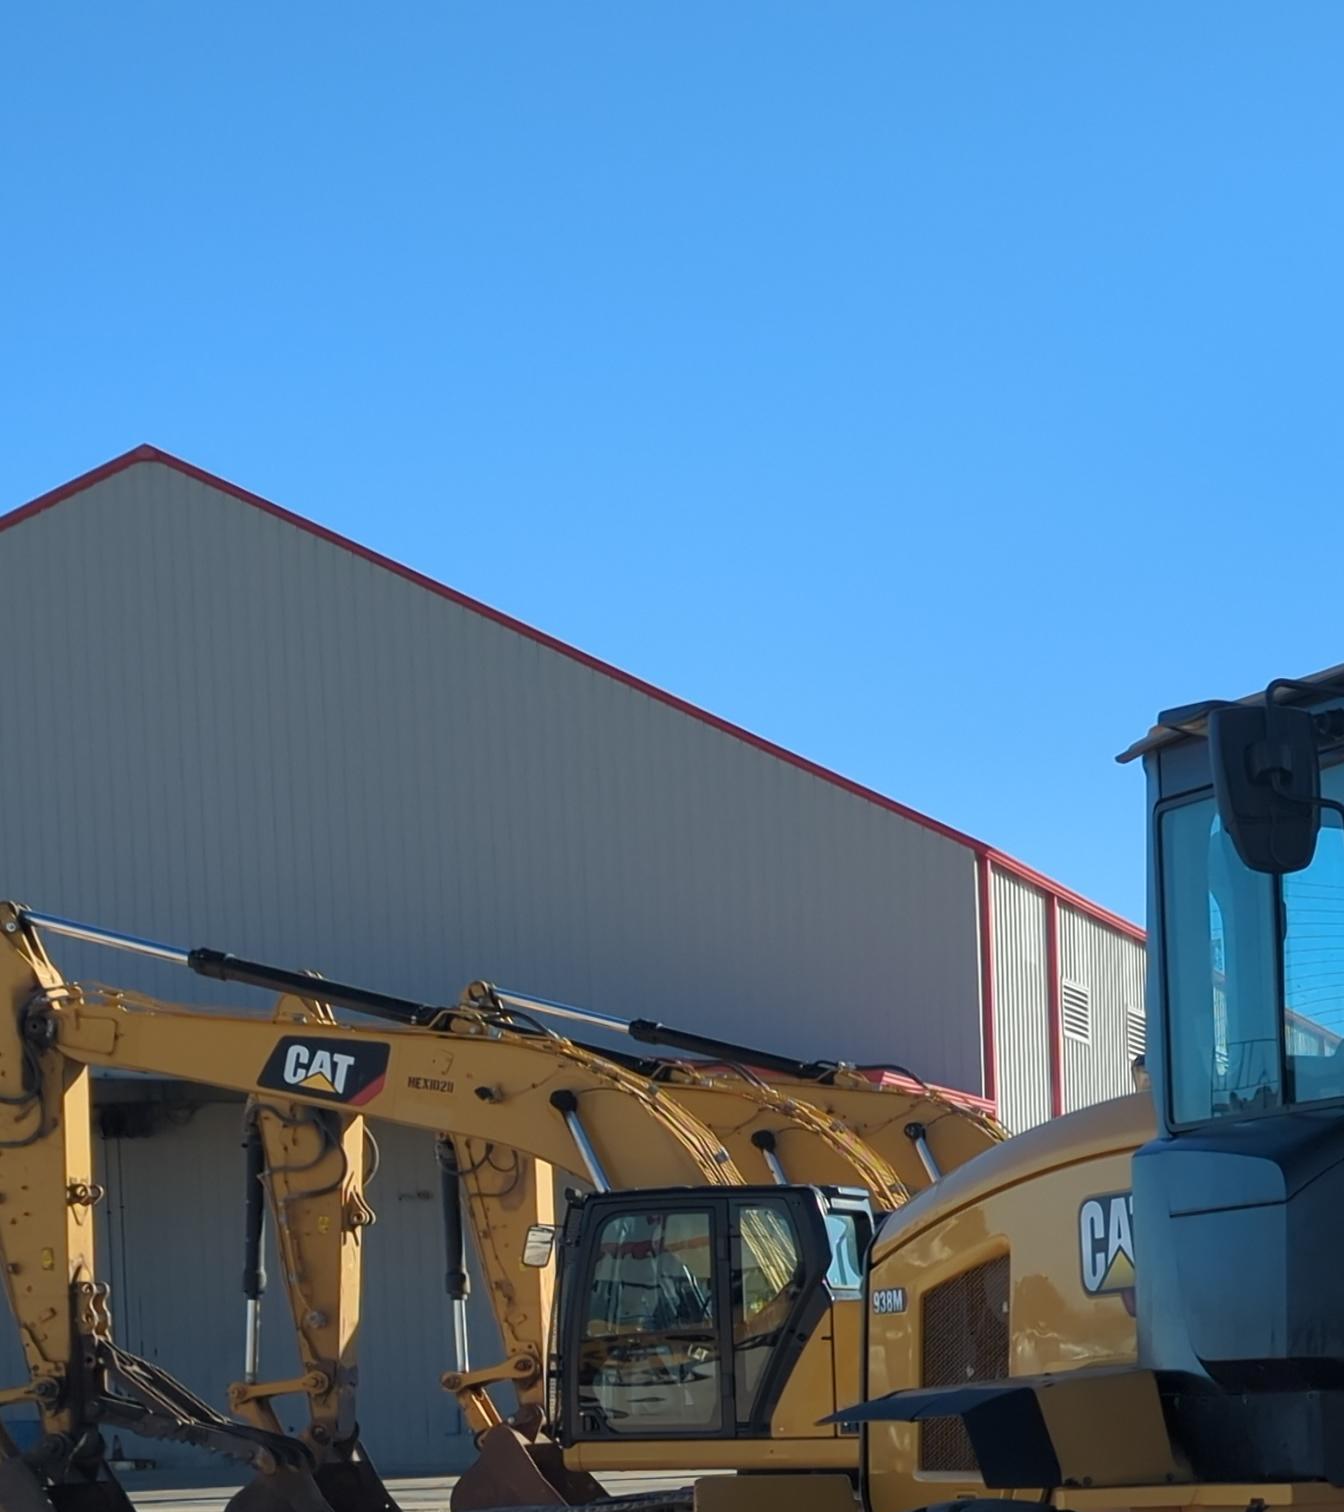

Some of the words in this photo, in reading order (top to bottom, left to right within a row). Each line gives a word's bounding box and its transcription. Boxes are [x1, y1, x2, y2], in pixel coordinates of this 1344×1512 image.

[283, 1044, 355, 1094] CAT
[1080, 1195, 1135, 1292] CA
[873, 1290, 903, 1313] 938M
